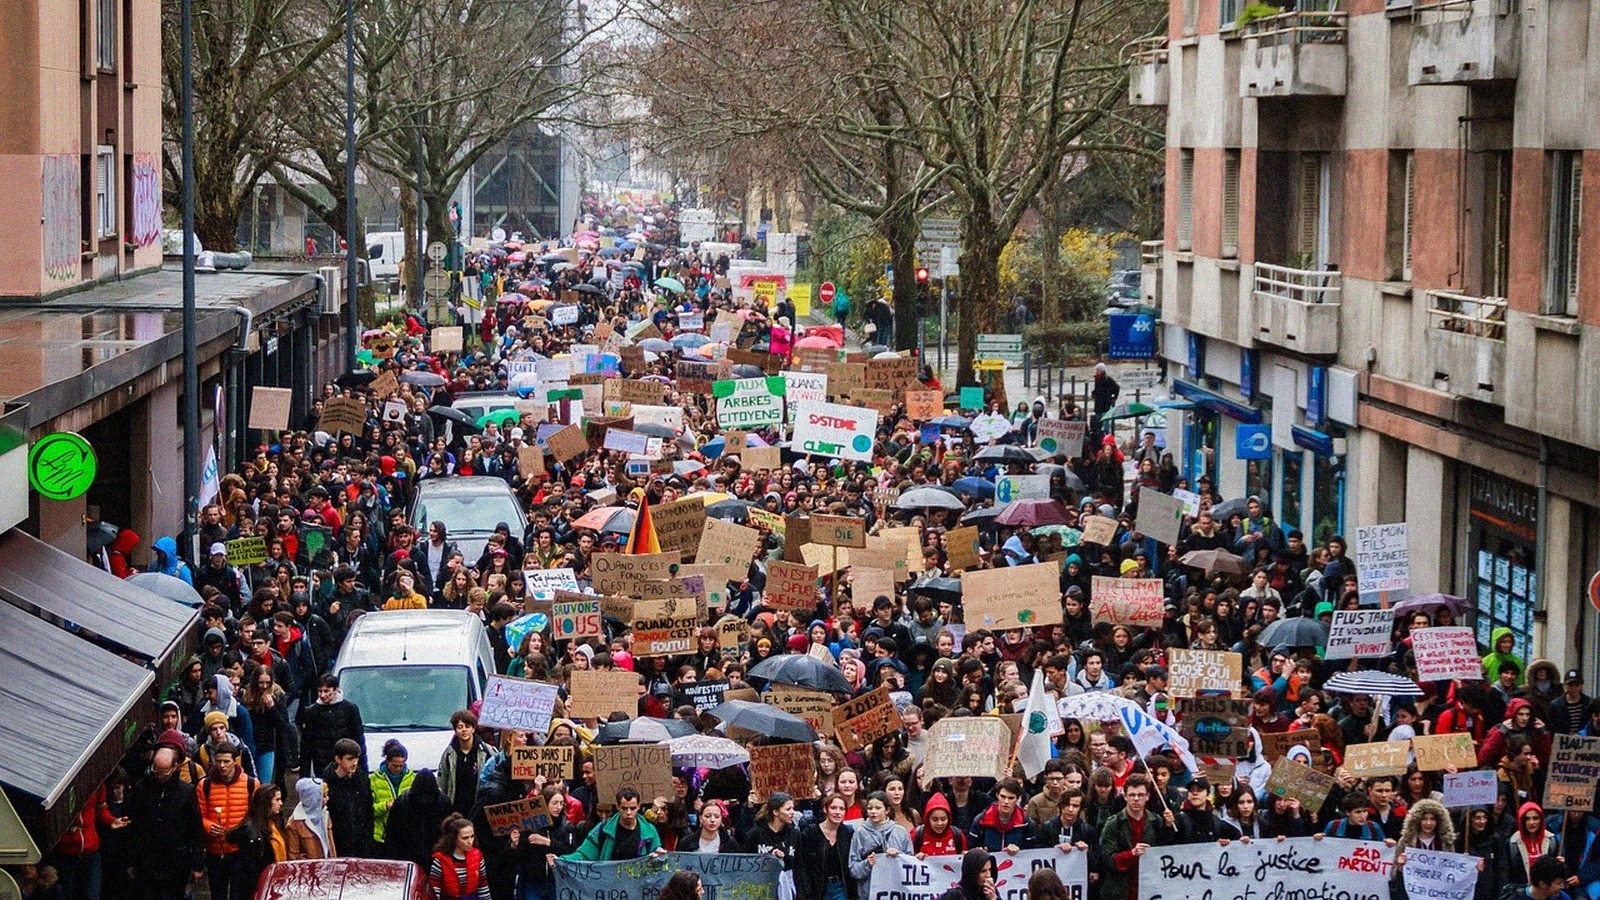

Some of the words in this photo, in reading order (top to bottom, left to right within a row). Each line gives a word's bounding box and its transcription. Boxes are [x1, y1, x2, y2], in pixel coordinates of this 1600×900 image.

[736, 378, 765, 393] AUX
[724, 396, 771, 408] ARBRES
[719, 409, 780, 425] CITOYENS
[809, 414, 857, 431] SYSTEME
[835, 530, 853, 539] DIE
[1359, 527, 1377, 539] DIS
[1380, 525, 1404, 537] MON
[596, 558, 634, 573] QUAND
[770, 566, 787, 578] ON
[600, 579, 627, 591] C'EST
[644, 584, 664, 595] PAS
[554, 602, 599, 615] SAUVONS
[1334, 611, 1365, 624] PLUS
[1368, 611, 1394, 623] TARD
[635, 621, 674, 631] QUAND
[1331, 627, 1343, 636] JE
[1346, 624, 1391, 636] VOUDRAIS
[1353, 643, 1387, 655] VIVANT
[1172, 651, 1188, 663] LA
[1189, 651, 1224, 665] SEULE
[1170, 664, 1205, 676] CHOSE
[1207, 666, 1230, 679] QUI
[1171, 676, 1198, 688] DOIT
[764, 694, 779, 704] Et
[1560, 736, 1597, 750] HAUT
[517, 750, 539, 760] TOUS
[541, 750, 561, 761] DANS
[563, 749, 572, 762] LA
[1557, 752, 1571, 760] LES
[536, 763, 565, 778] MERDE
[622, 768, 642, 781] ON
[1566, 796, 1590, 806] BAIN
[1353, 847, 1381, 860] ZAD
[1418, 853, 1436, 865] QUI
[1160, 855, 1211, 879] Pour
[1218, 851, 1240, 877] la
[1254, 846, 1323, 881] justice
[1338, 858, 1394, 875] PARTOUT
[902, 864, 930, 886] ILS
[1446, 873, 1456, 884] A
